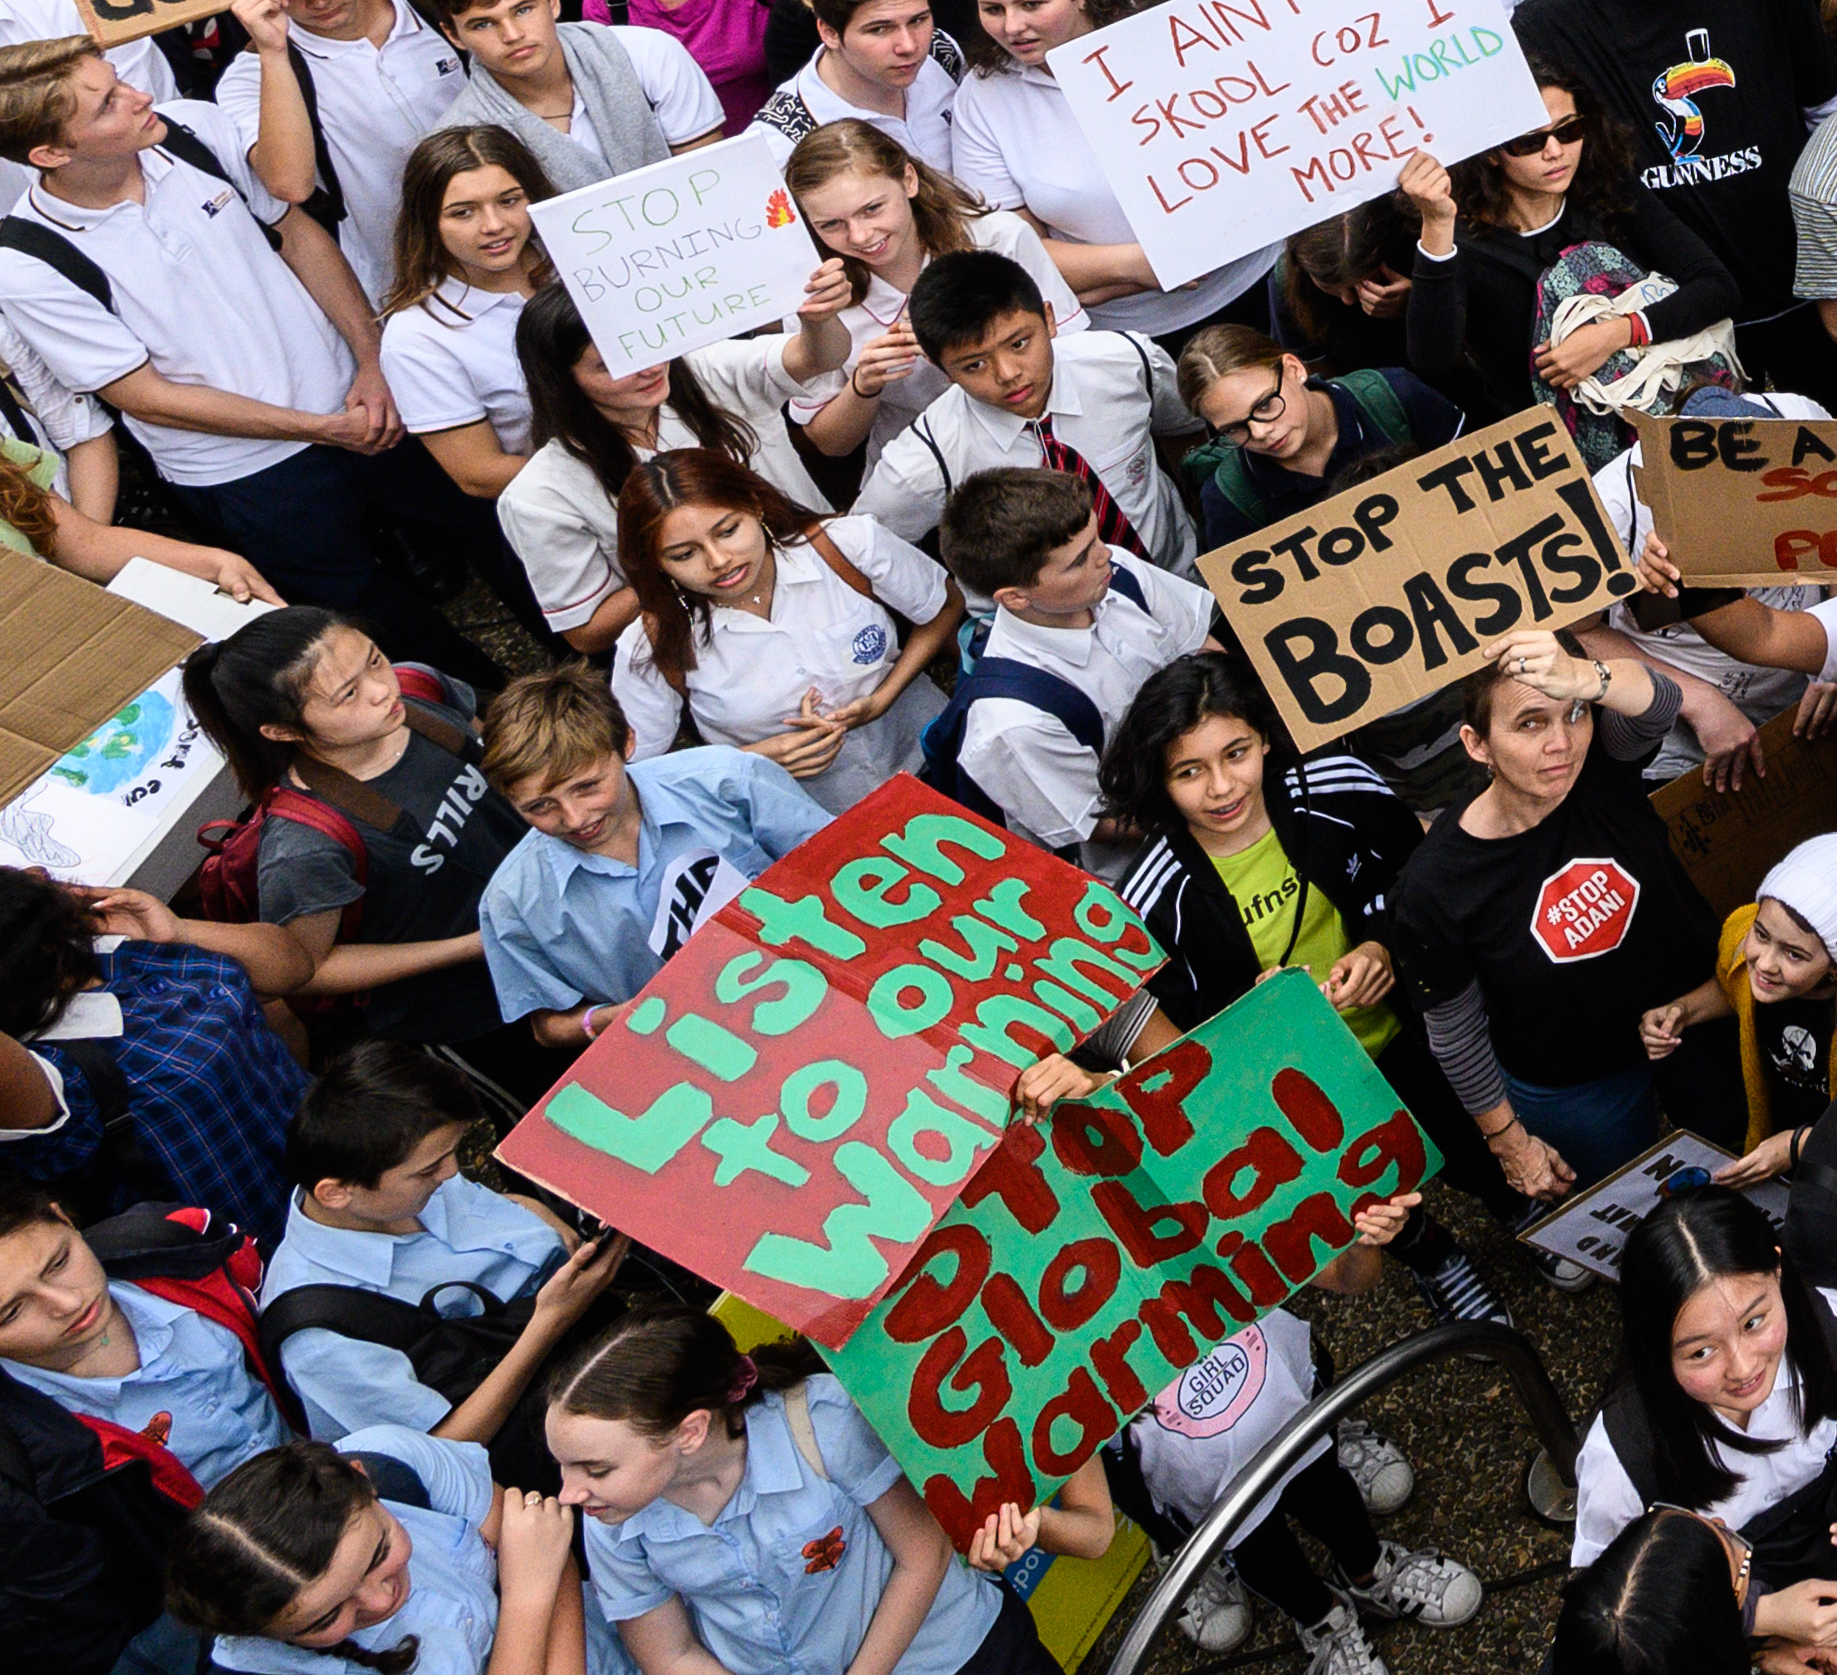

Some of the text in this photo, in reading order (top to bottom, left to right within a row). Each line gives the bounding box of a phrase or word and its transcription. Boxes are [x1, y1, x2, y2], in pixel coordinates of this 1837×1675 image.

[1229, 421, 1572, 608] STOP THE
[1262, 482, 1639, 726] BOASTS!
[1545, 870, 1610, 928] #STOP
[1563, 889, 1629, 953] ADANI
